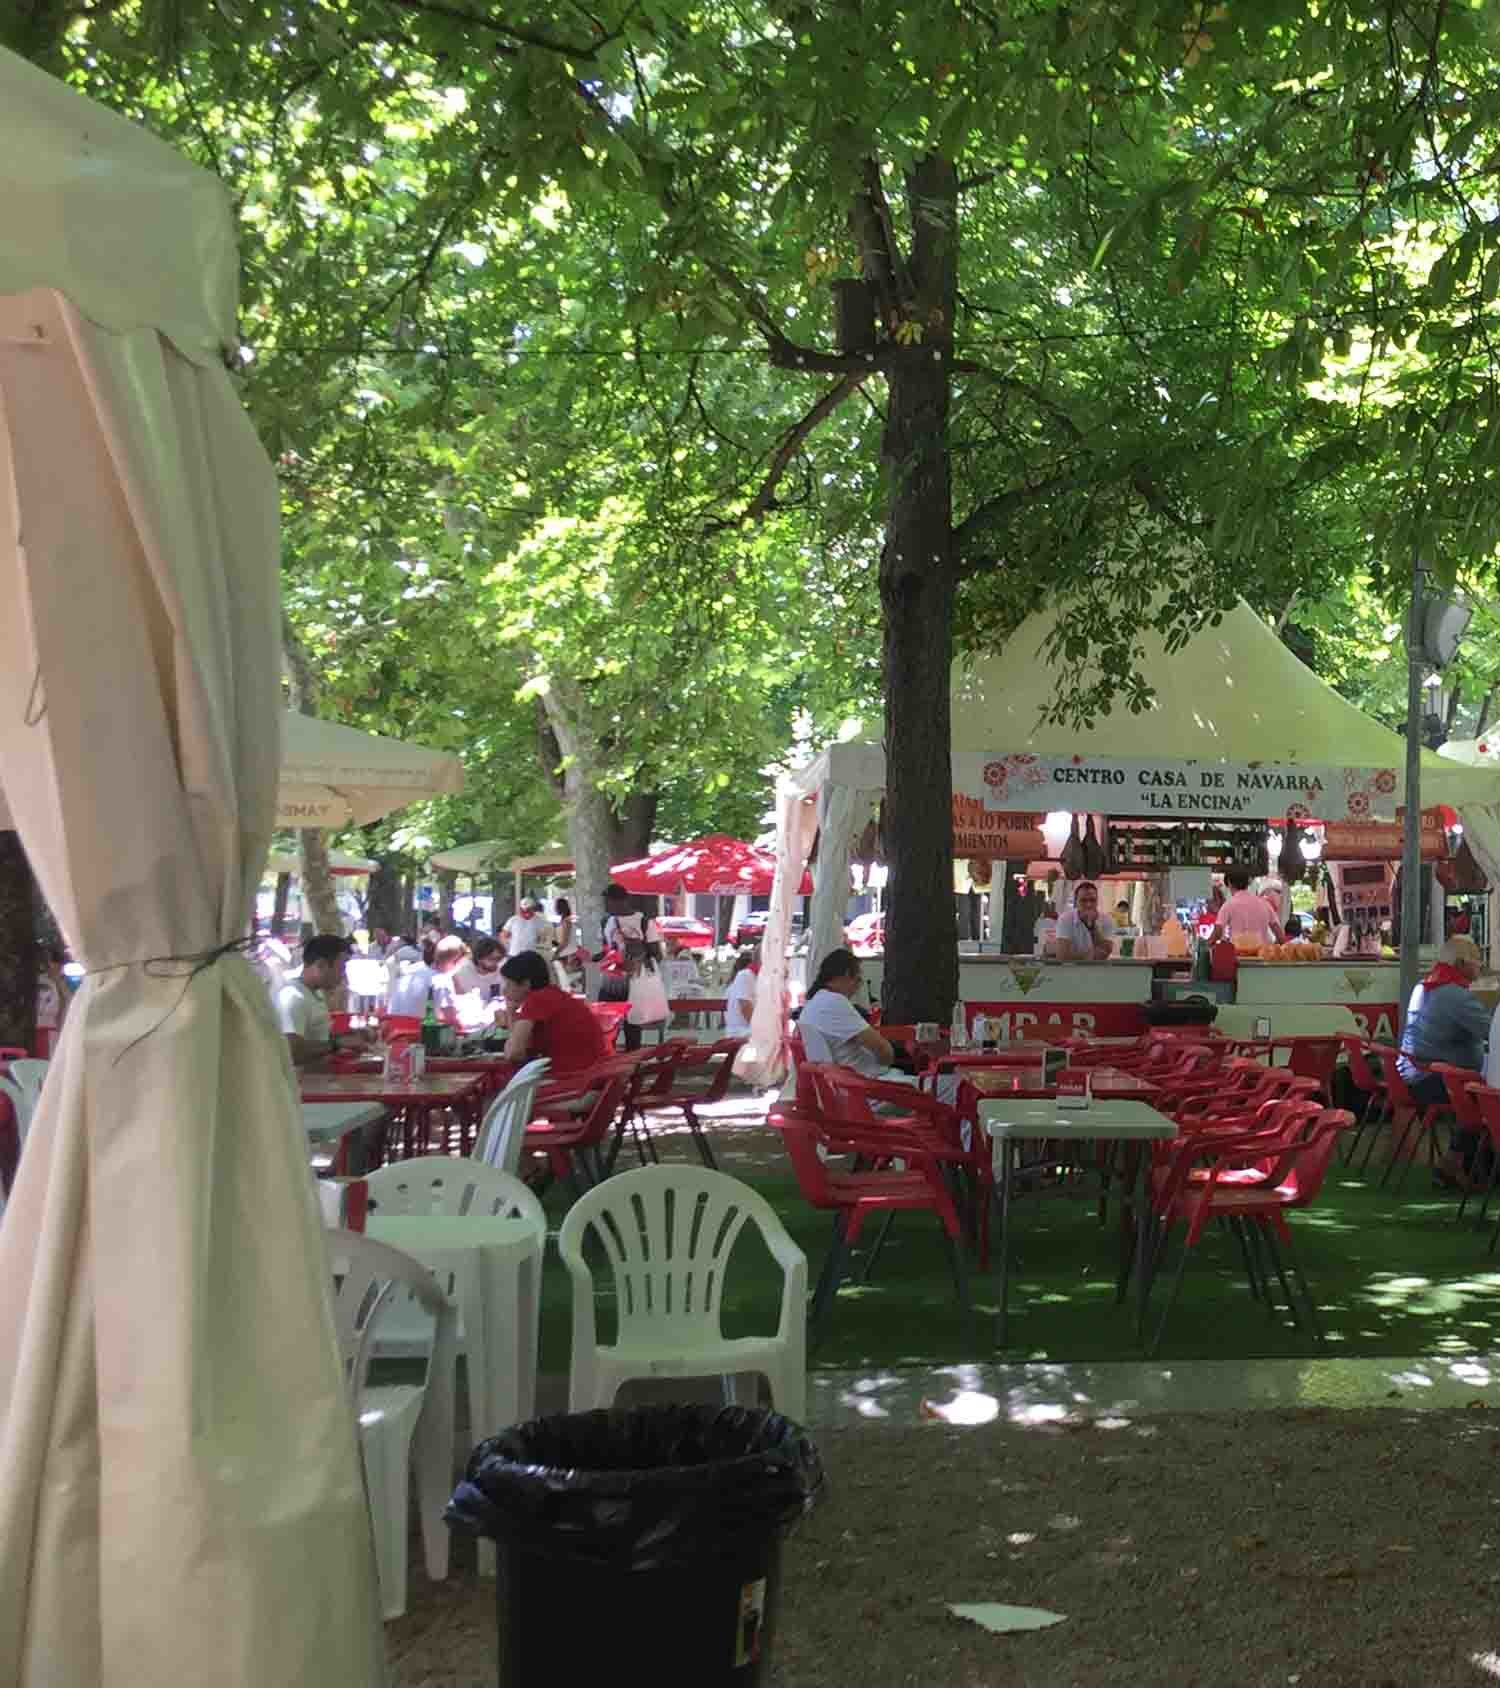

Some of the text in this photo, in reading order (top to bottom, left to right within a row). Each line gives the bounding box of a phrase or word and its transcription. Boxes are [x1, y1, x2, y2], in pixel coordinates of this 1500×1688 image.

[1053, 768, 1324, 791] CENTRO CASA DE NAVARRA
